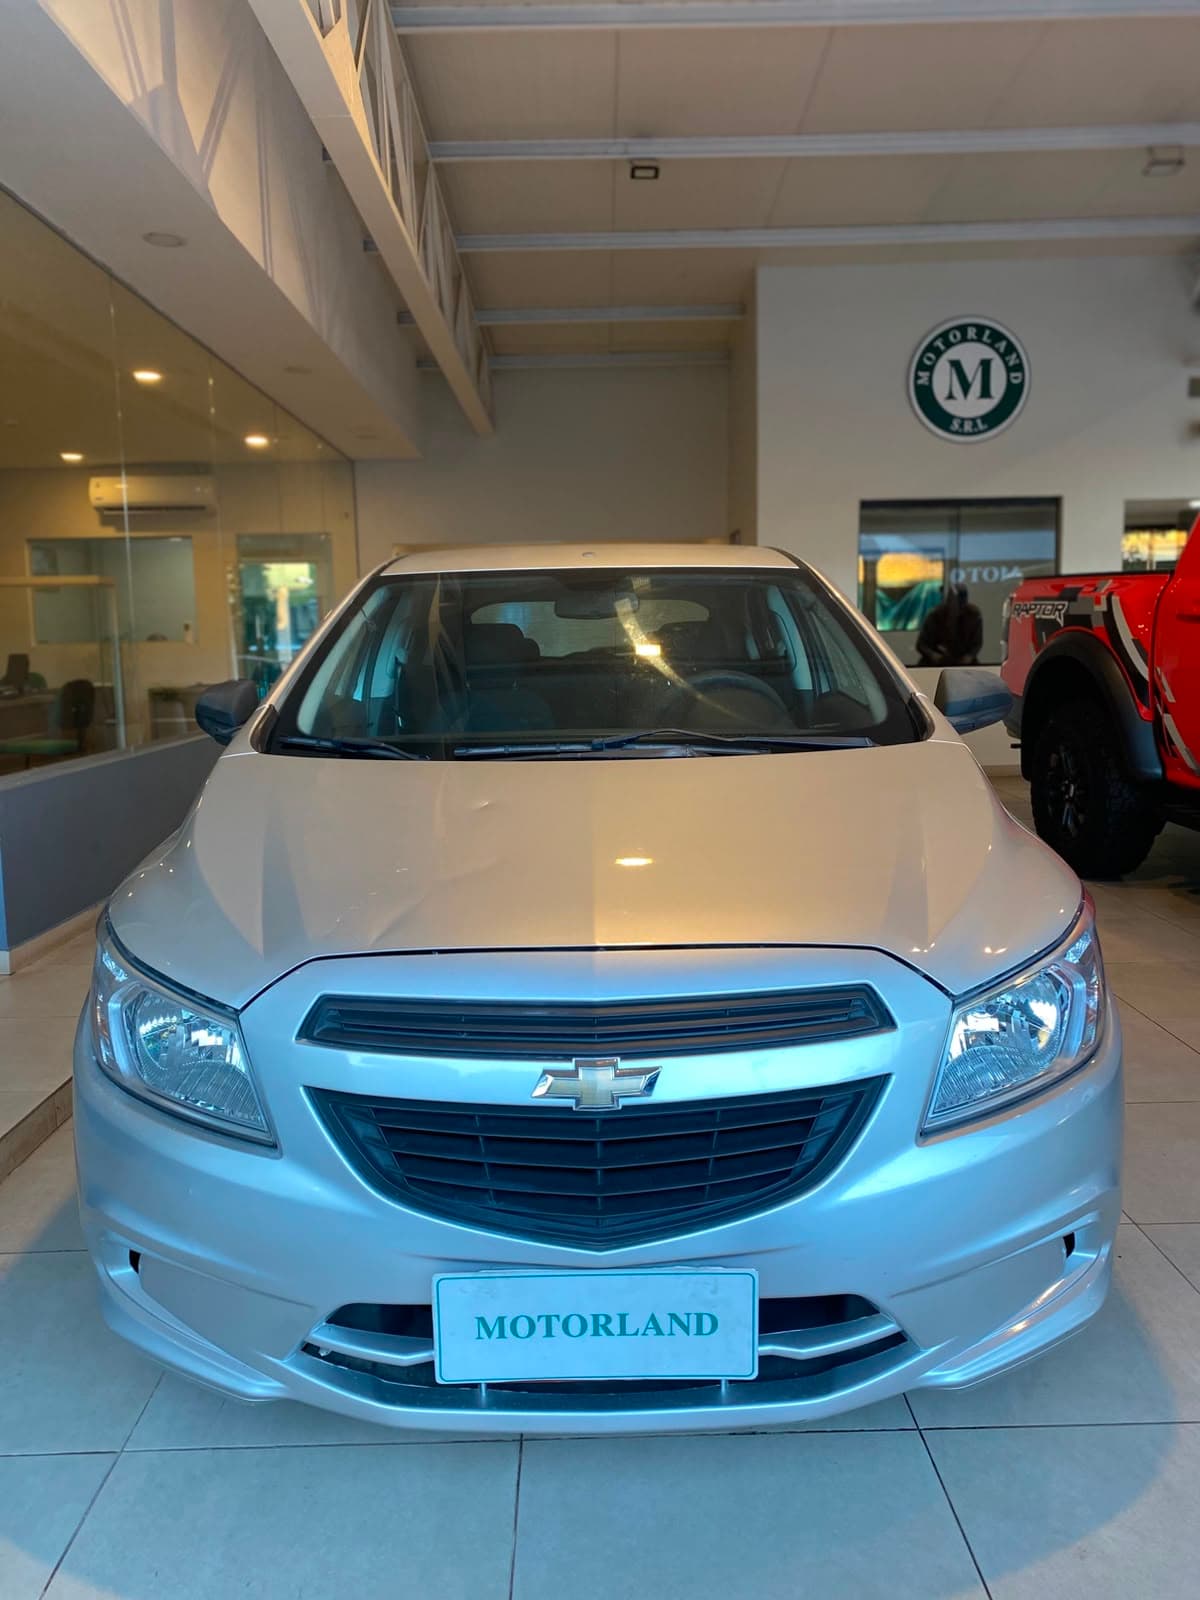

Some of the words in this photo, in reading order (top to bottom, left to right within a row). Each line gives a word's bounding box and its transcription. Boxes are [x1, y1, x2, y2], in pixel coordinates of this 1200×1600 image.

[917, 326, 1022, 386] MOTORLAND
[944, 358, 995, 401] M
[1012, 601, 1068, 627] RAPTOR
[475, 1311, 719, 1340] MOTORLAND
